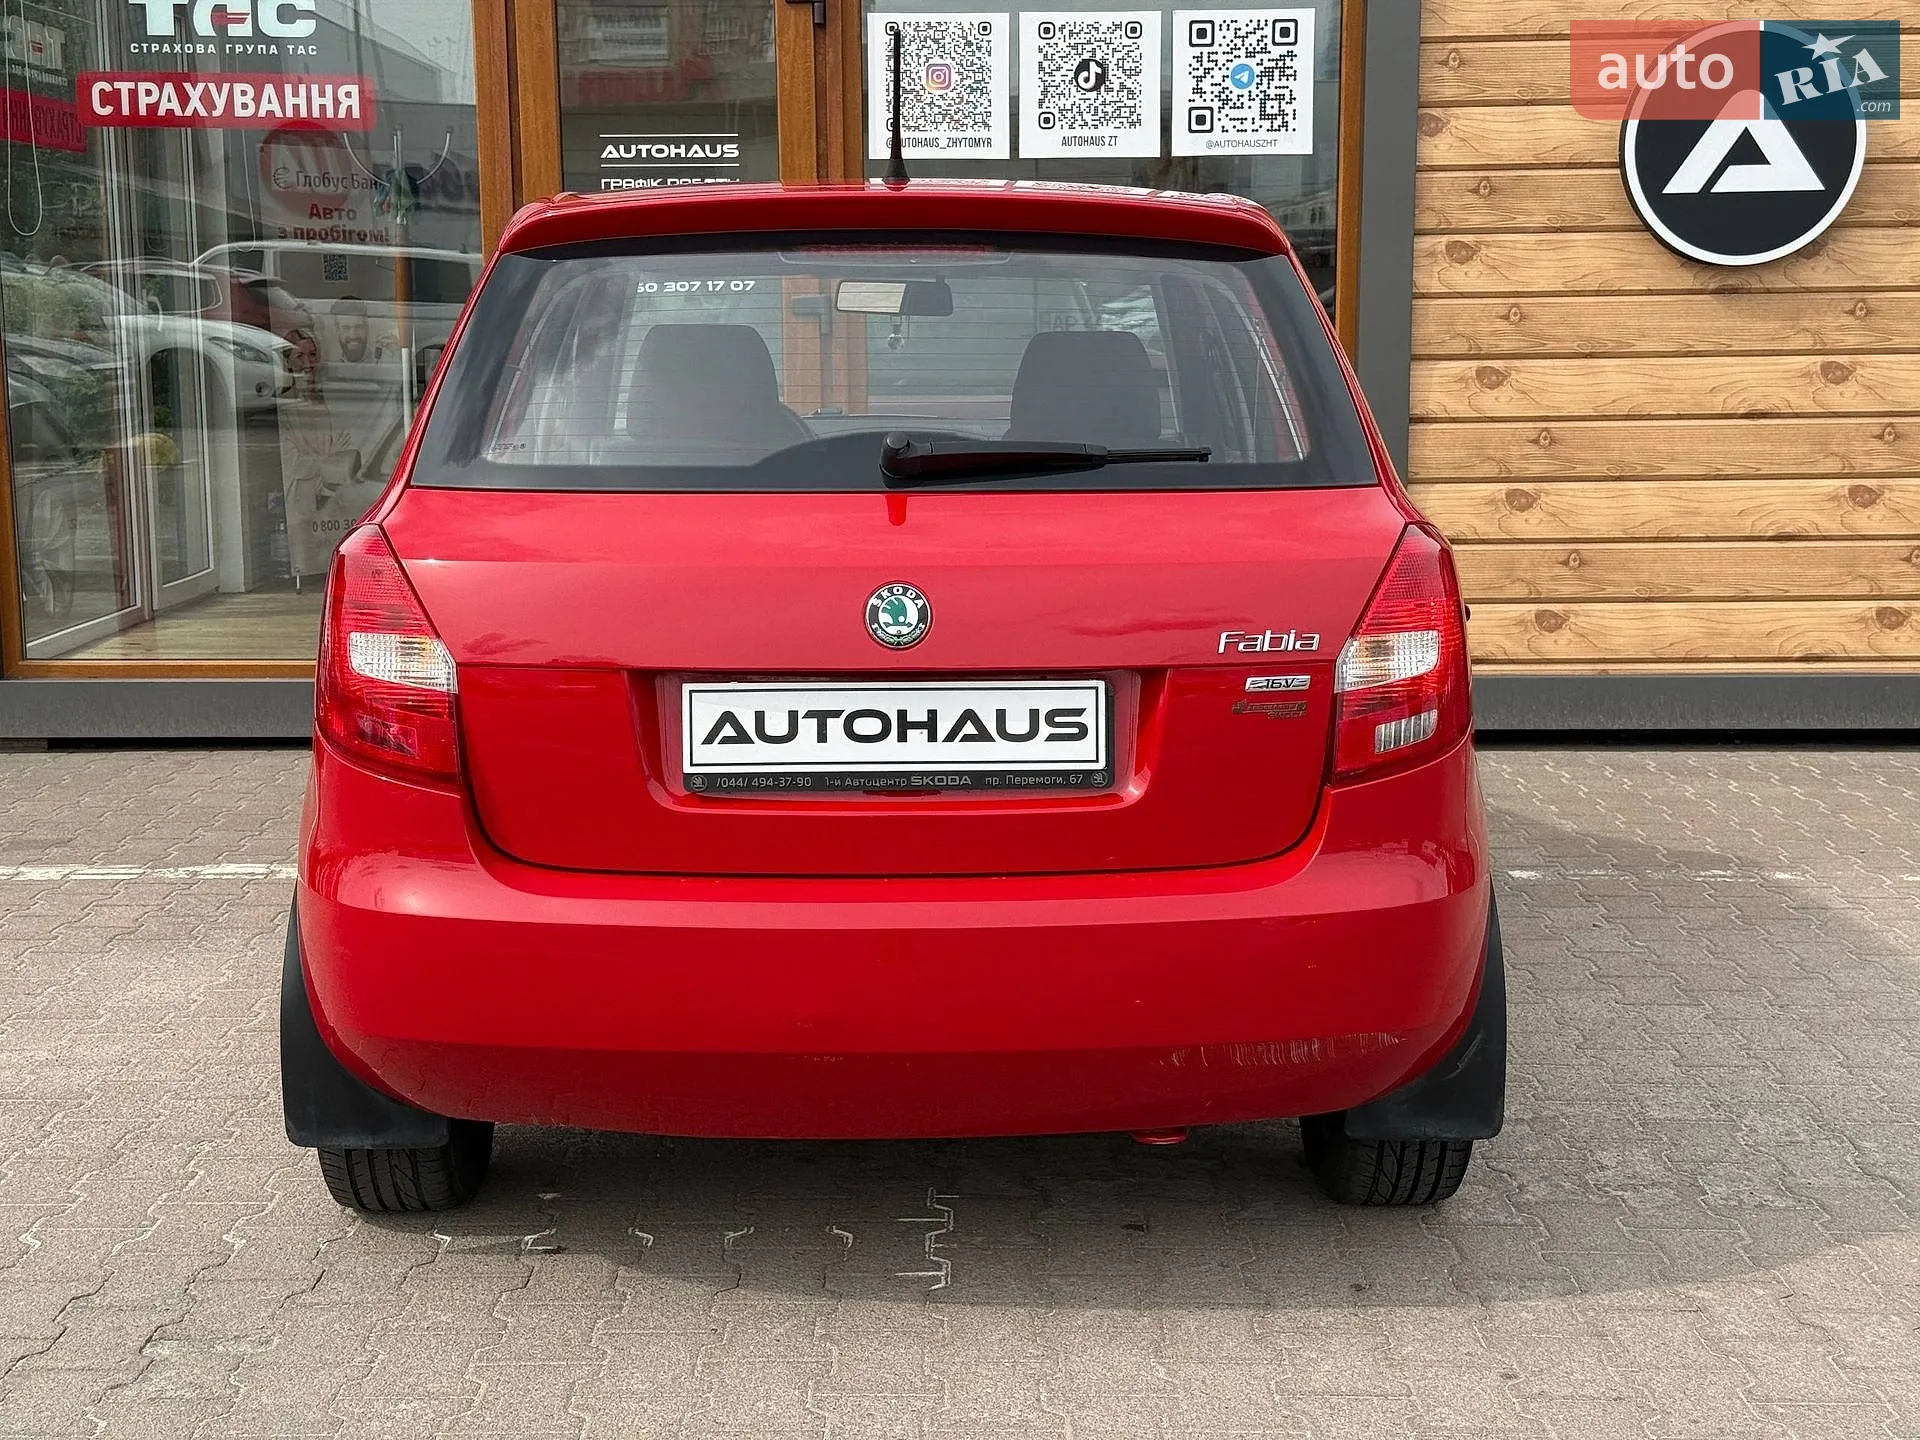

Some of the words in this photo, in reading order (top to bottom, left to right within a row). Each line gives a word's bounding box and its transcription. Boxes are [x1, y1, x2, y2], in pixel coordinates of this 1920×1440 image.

[130, 43, 216, 54] СТРАХОВА
[226, 44, 278, 55] ГРУПА
[287, 45, 317, 55] ТАС
[91, 81, 360, 119] СТРАХУВАННЯ
[886, 137, 992, 149] @UTOHAUS_ZHYTOMYR
[1061, 135, 1105, 147] AUTOHAUS
[1108, 135, 1119, 147] ZT
[1205, 139, 1278, 149] @AUTOHAUSZHT
[600, 144, 740, 158] AUTOHAUS
[295, 171, 348, 191] Глобус
[308, 203, 357, 220] Авто
[292, 224, 389, 243] пробігом!
[663, 281, 701, 292] 307
[706, 281, 725, 291] 17
[730, 281, 755, 291] 07
[312, 520, 319, 533] 0
[321, 519, 340, 532] 800
[1217, 629, 1320, 654] Fabia
[1265, 678, 1296, 690] 16V
[700, 708, 1089, 745] AUTOHAUS
[716, 776, 748, 788] /044/
[751, 776, 812, 788] 494-37-90
[844, 775, 908, 788] Автоцентр
[1006, 774, 1066, 785] Перемоги,
[1069, 774, 1083, 784] 67
